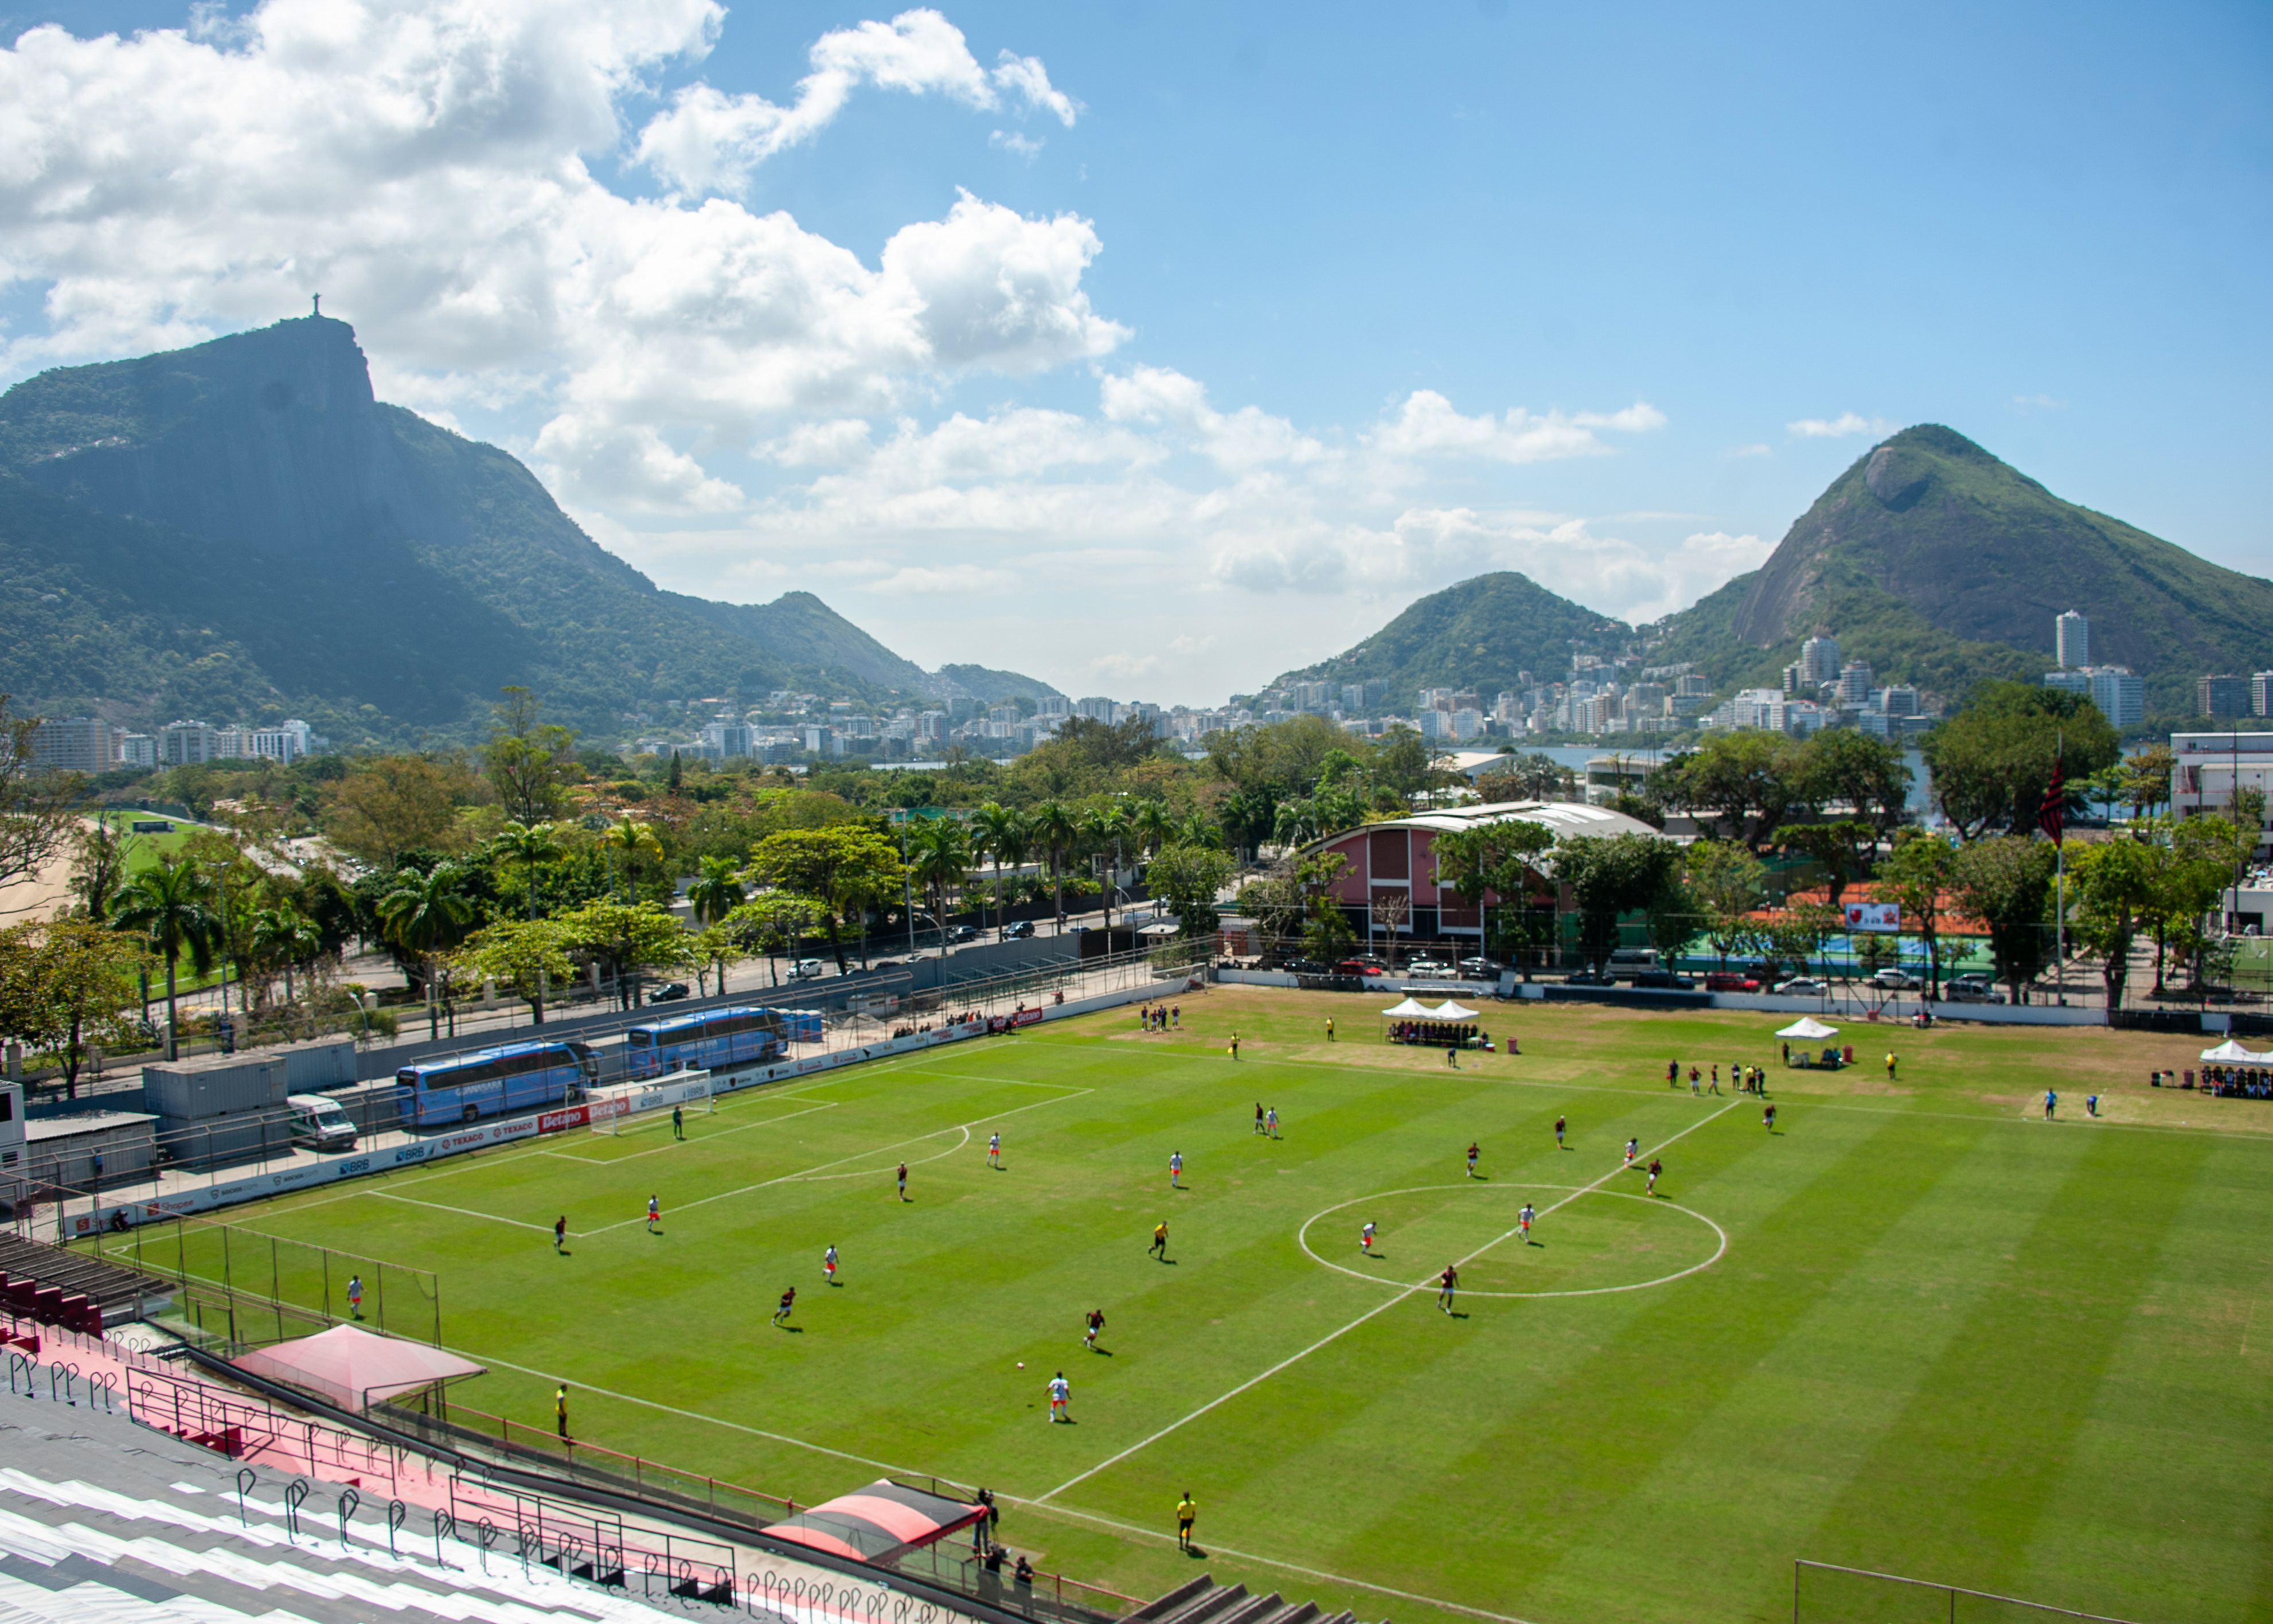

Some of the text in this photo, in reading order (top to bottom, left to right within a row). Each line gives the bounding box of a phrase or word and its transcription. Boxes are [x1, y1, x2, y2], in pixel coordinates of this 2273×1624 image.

[589, 1101, 626, 1118] Betano
[542, 1111, 581, 1129] Betano
[504, 1122, 533, 1134] TEXACO
[453, 1133, 484, 1146] TEXACO
[405, 1147, 425, 1160] BRB
[350, 1158, 370, 1172] BRB
[162, 1200, 194, 1212] Shopee
